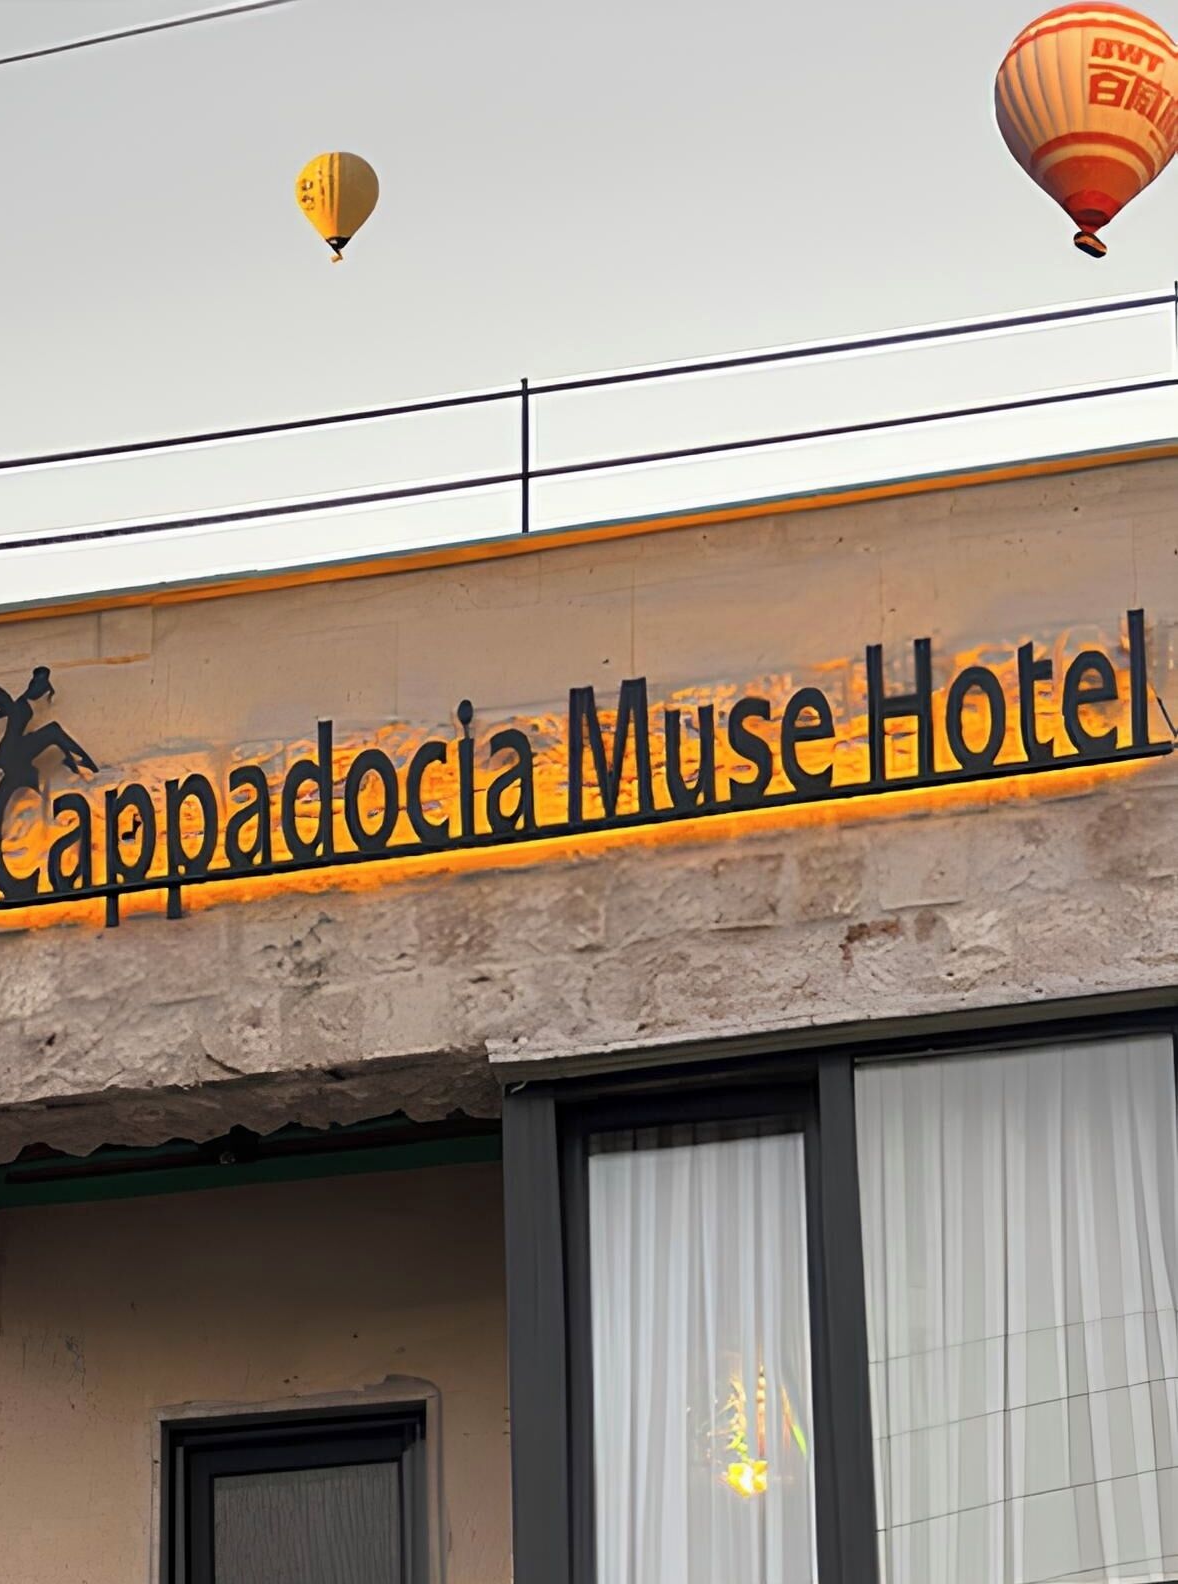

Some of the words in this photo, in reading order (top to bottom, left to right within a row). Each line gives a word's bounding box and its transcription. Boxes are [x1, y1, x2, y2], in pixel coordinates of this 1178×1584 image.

[1091, 38, 1164, 72] BWT
[568, 676, 835, 825] Muse
[866, 608, 1150, 785] Hotel
